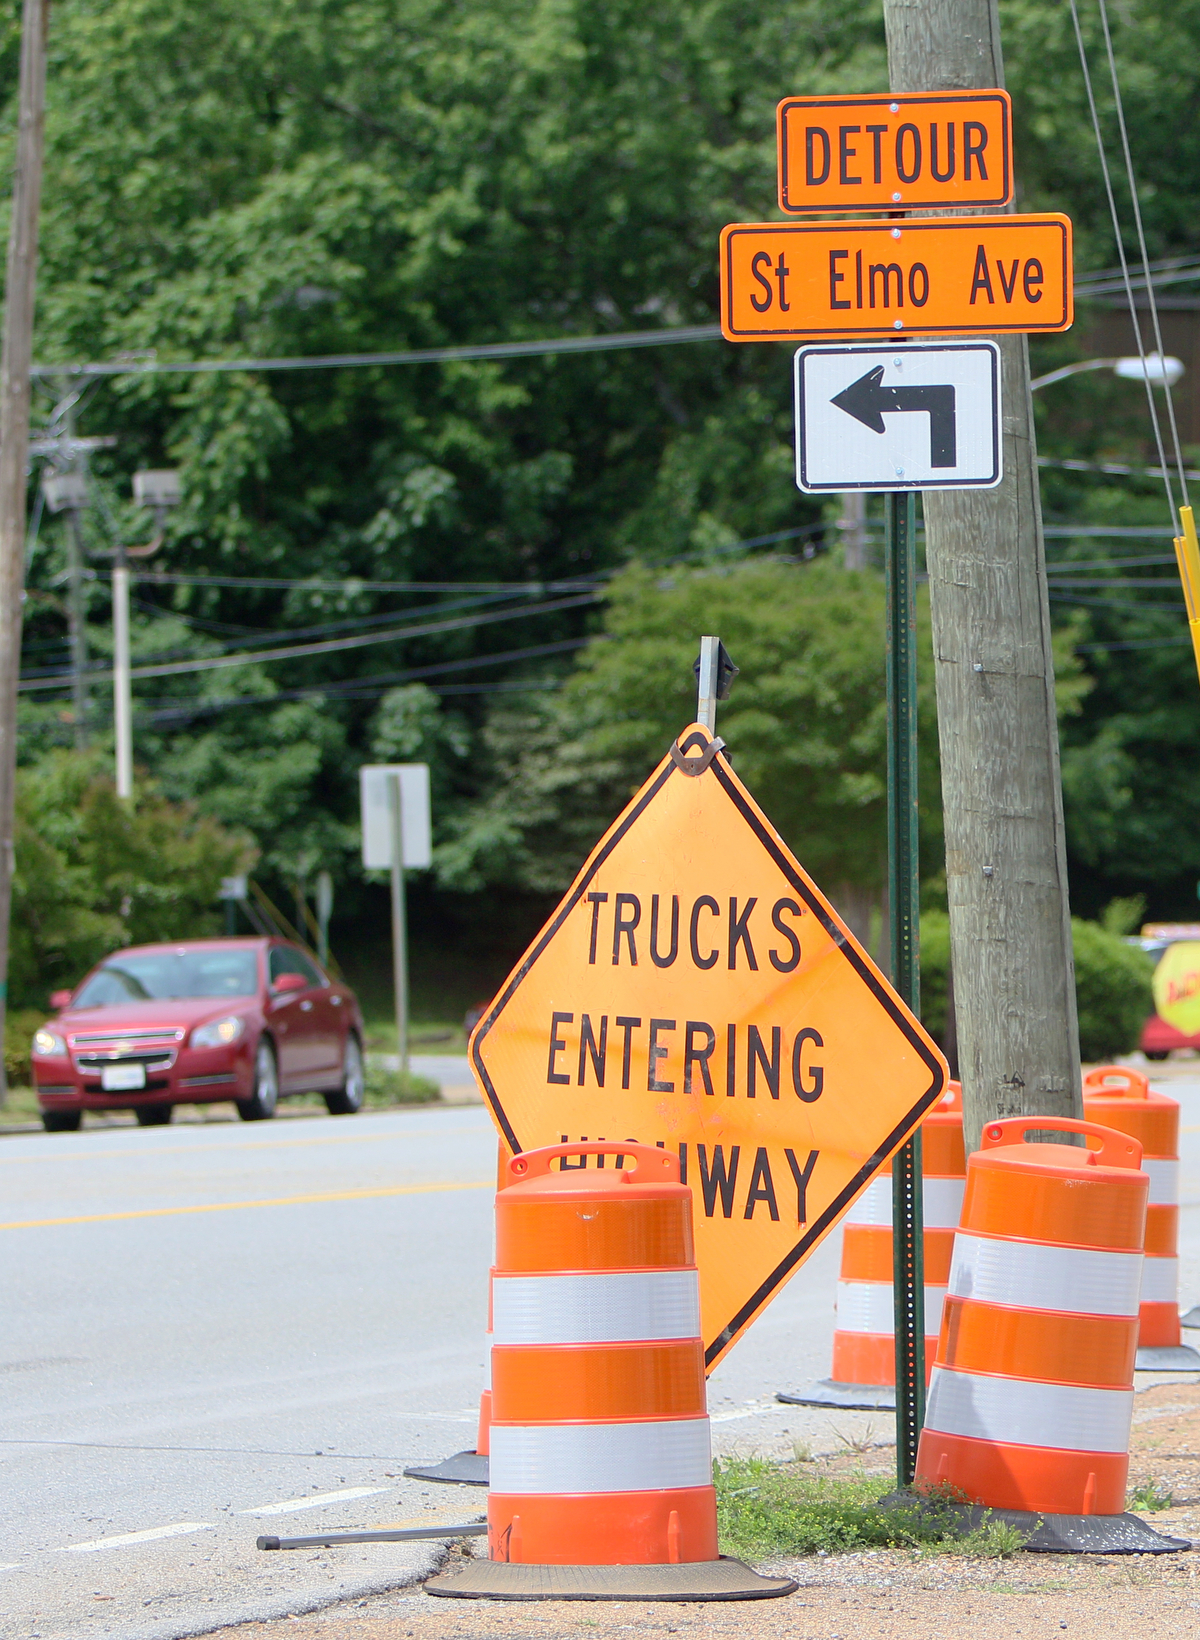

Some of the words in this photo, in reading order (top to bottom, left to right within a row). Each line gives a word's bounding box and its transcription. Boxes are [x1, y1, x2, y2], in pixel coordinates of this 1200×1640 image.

[804, 121, 989, 186] DETOUR
[749, 250, 791, 313] St
[828, 248, 930, 310] Elmo
[968, 244, 1044, 305] Ave
[586, 892, 802, 973] TRUCKS
[546, 1011, 825, 1103] ENTERING
[559, 1134, 820, 1222] HWAY
